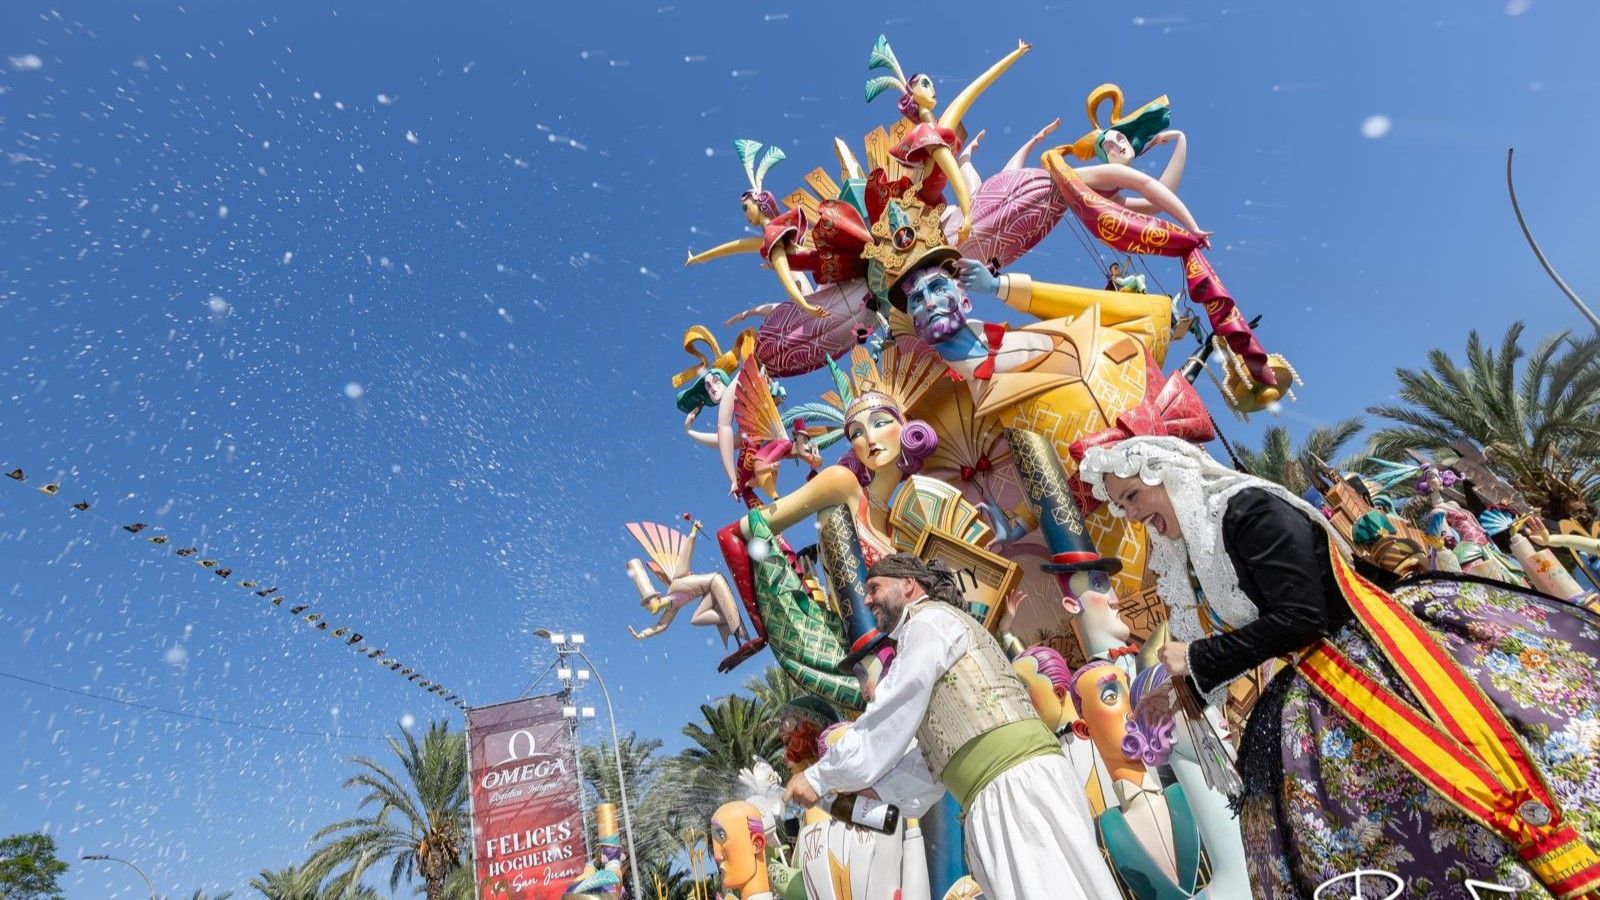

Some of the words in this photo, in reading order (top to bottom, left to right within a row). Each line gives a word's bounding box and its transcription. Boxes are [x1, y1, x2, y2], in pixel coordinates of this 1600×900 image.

[481, 758, 566, 789] OMEGA
[486, 821, 571, 859] FELICES
[488, 845, 573, 877] HOGUERAS
[512, 873, 539, 893] San
[543, 866, 576, 886] Juan
